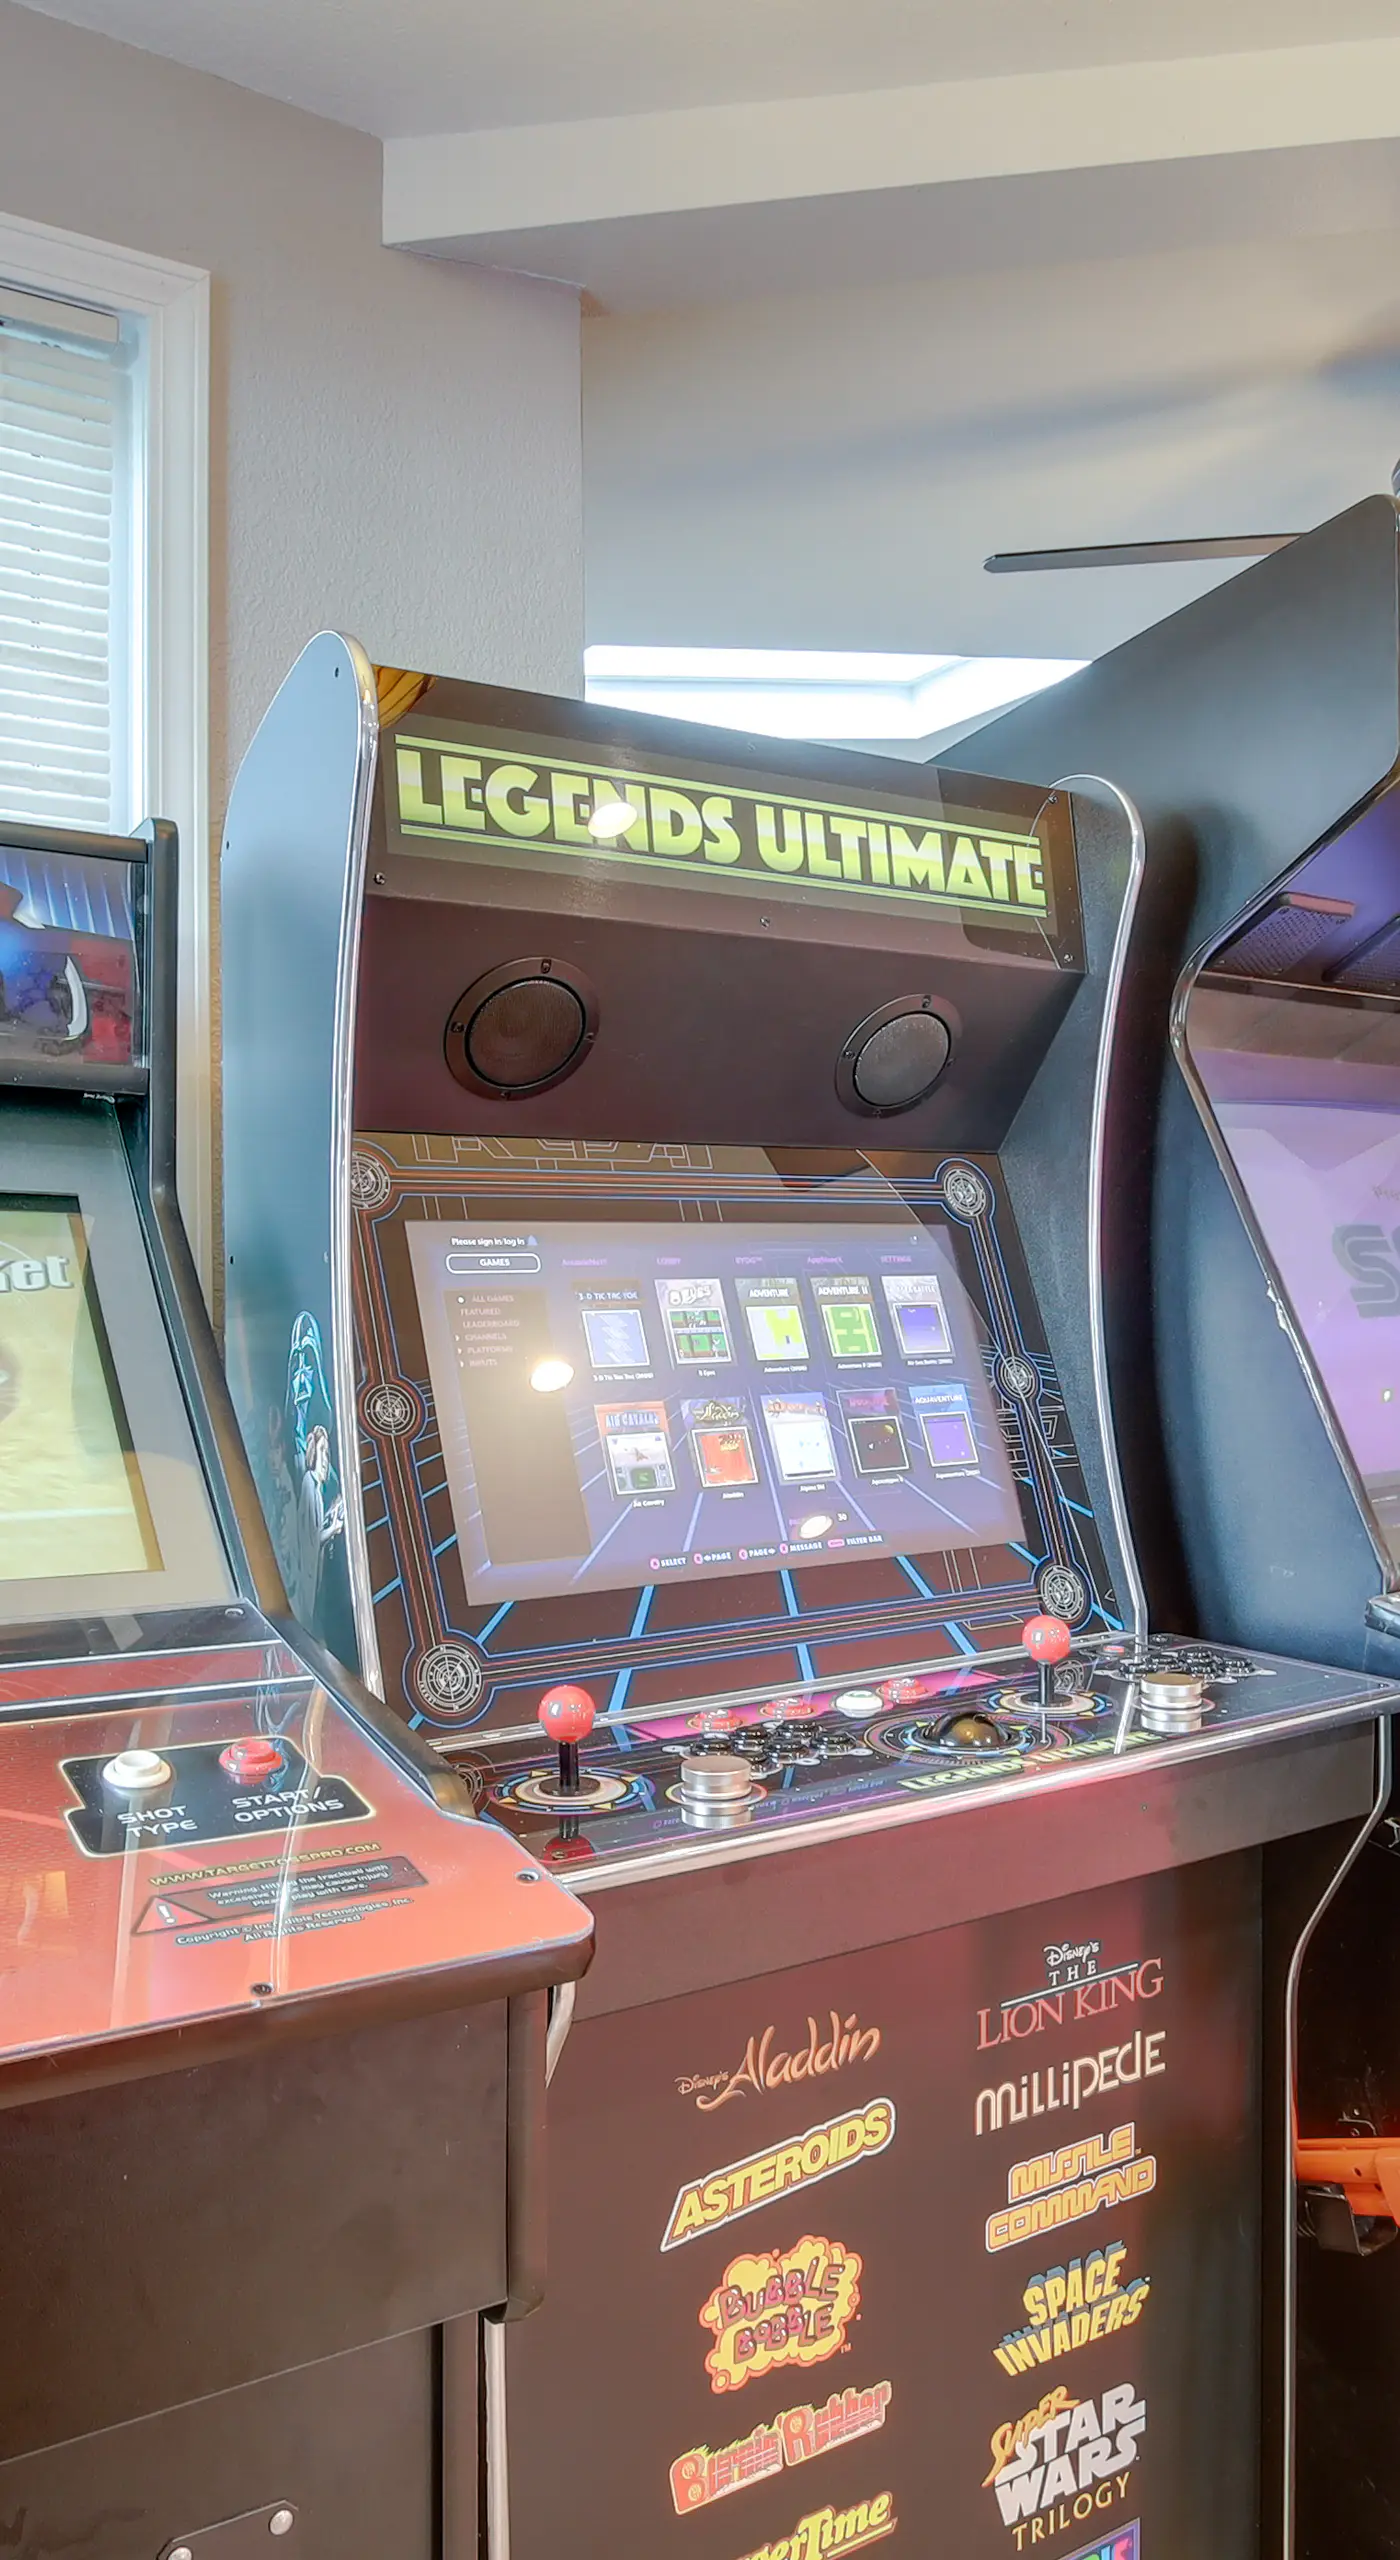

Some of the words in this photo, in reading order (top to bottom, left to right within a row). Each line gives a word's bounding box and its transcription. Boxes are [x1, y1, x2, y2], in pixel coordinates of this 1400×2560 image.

[396, 748, 742, 865] LEGENDS
[755, 804, 1048, 907] ULTIMATE
[451, 1237, 477, 1246] Please
[478, 1237, 493, 1247] sign
[479, 1258, 511, 1267] GAMES
[749, 1287, 790, 1298] ADVENTURE
[818, 1285, 860, 1297] ADVENTURE
[660, 1556, 687, 1568] SELECT
[711, 1551, 732, 1562] PAGE
[749, 1548, 769, 1558] PAGE
[789, 1541, 823, 1552] MESSAGE
[117, 1805, 188, 1825] SHOT
[127, 1818, 198, 1839] TYPE
[234, 1798, 345, 1823] OPTIONS
[176, 1926, 240, 1945] Copyright
[1043, 1940, 1101, 1968] Disney's
[976, 1992, 1064, 2051] LION
[1073, 1957, 1164, 2020] KING
[695, 2010, 881, 2111] Aladdin
[668, 2103, 890, 2242] ASTEROIDS
[1010, 2123, 1135, 2200] MISSILE
[987, 2158, 1156, 2250] COMMAND
[717, 2256, 846, 2328] BUBBLE
[1023, 2240, 1128, 2327] SPACE
[732, 2303, 836, 2365] BOBBLE
[992, 2278, 1151, 2377] INVADERS
[982, 2384, 1081, 2488] SUPER
[994, 2382, 1147, 2488] STAR
[994, 2416, 1147, 2527] WARS
[1011, 2471, 1132, 2553] TRILOGY
